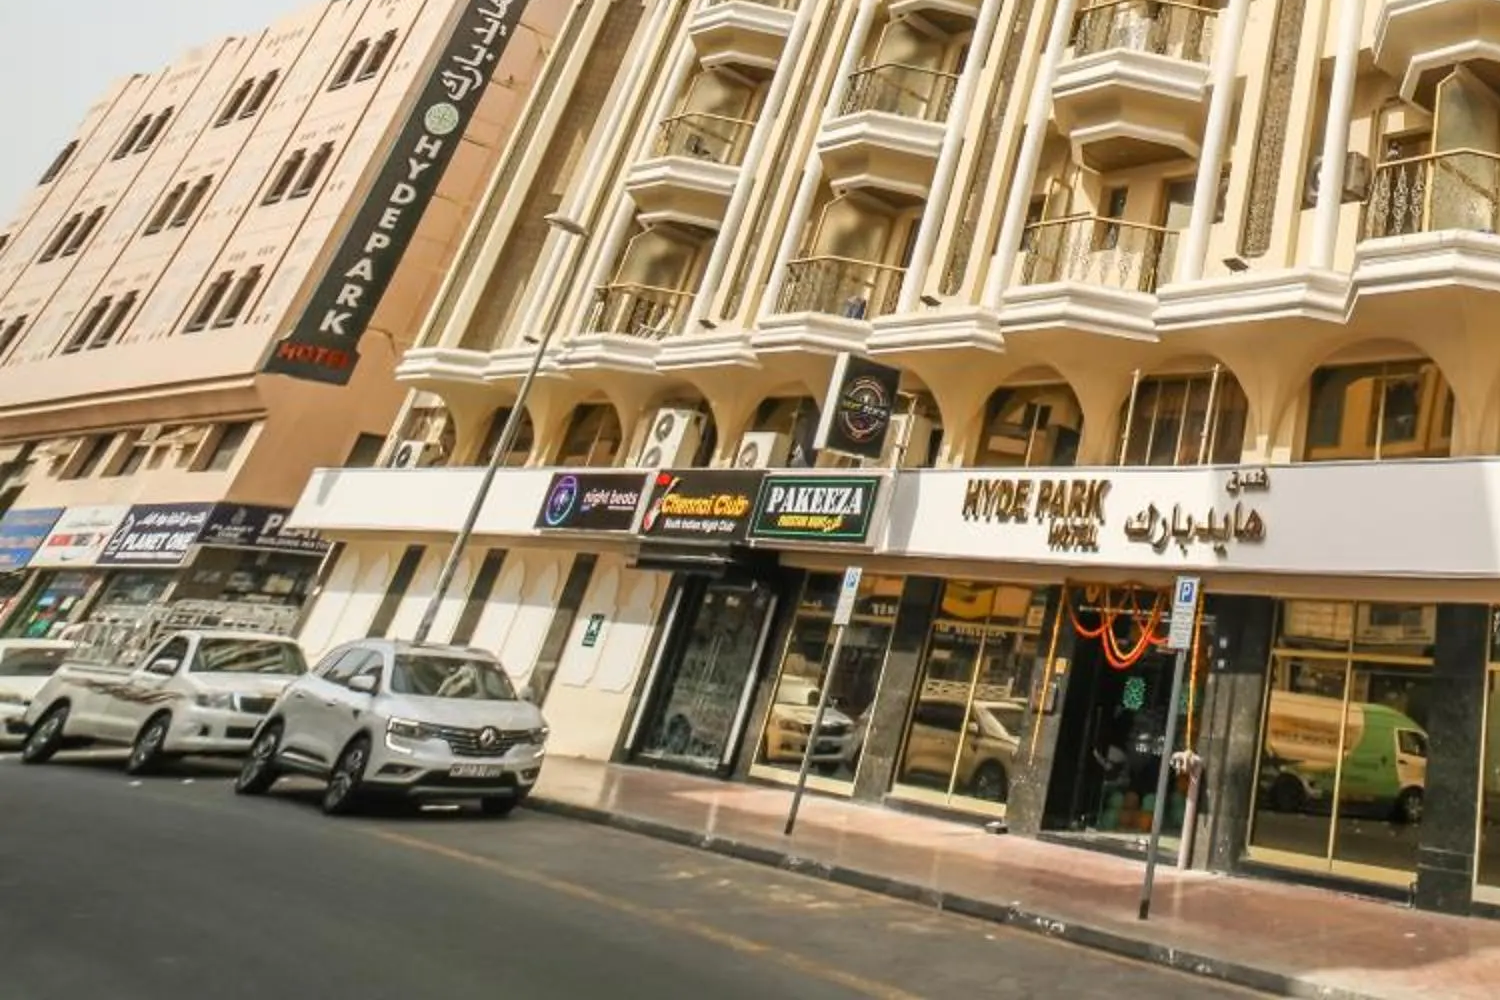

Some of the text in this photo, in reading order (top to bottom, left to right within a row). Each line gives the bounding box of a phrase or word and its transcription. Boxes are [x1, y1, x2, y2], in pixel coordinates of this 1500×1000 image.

[713, 493, 749, 516] Club
[765, 486, 864, 515] PAKEEZA
[962, 478, 1113, 526] HYDE PARK
[1181, 583, 1192, 601] P
